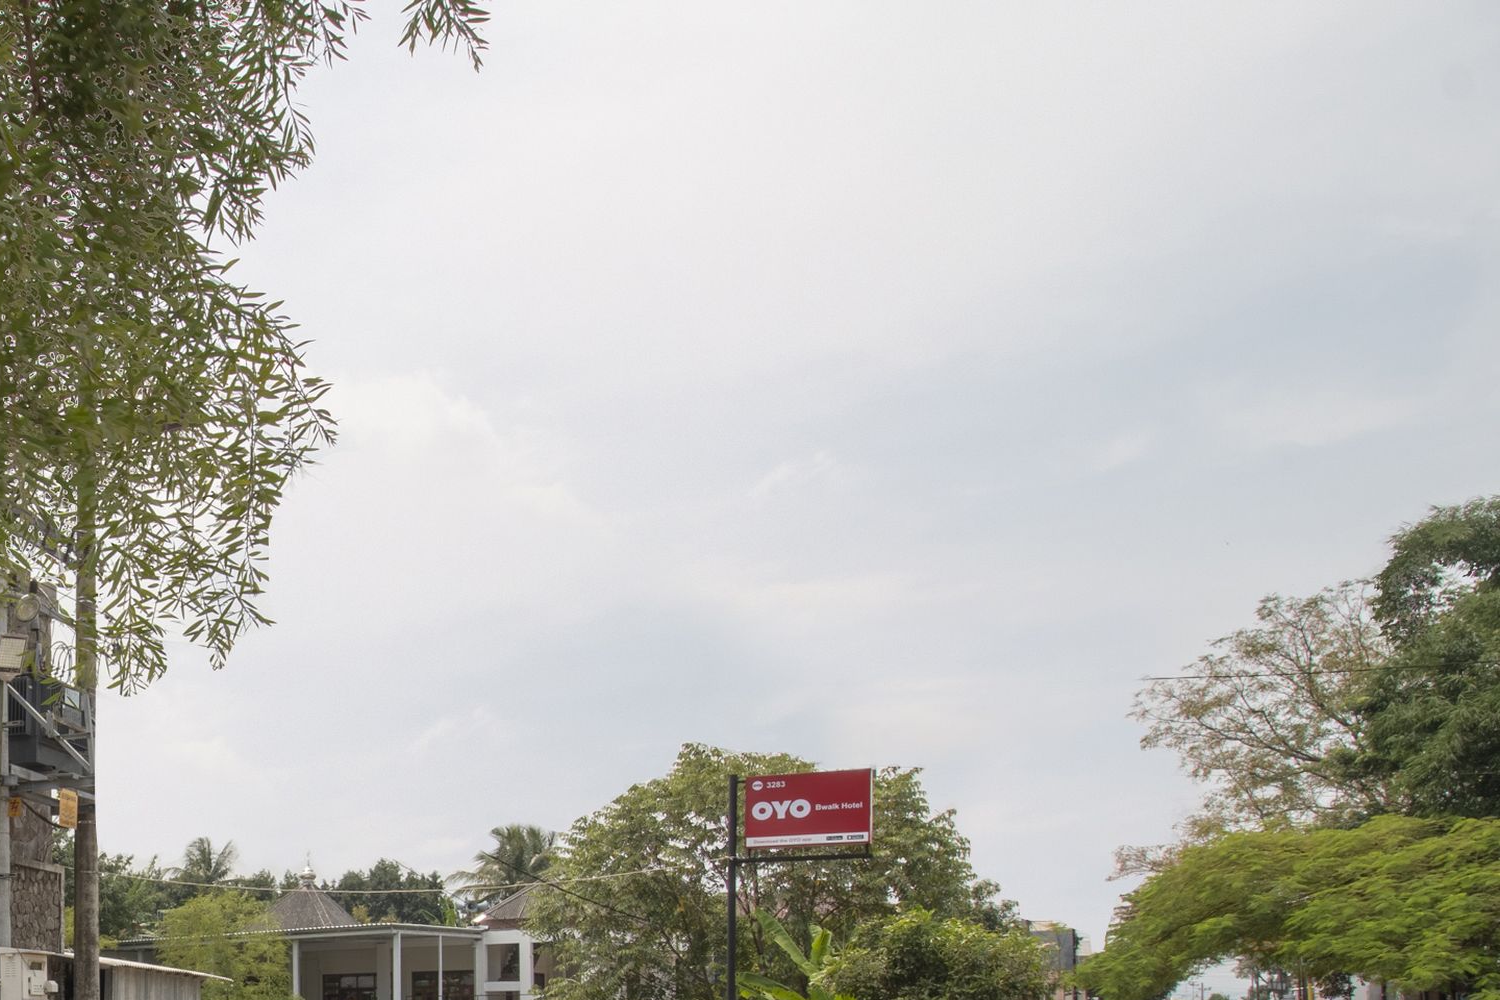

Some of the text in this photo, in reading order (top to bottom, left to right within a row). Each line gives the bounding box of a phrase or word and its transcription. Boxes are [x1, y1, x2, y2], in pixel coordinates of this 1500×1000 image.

[766, 781, 786, 789] 3283
[751, 798, 812, 821] OYO
[815, 801, 864, 811] Bwalk Hotel
